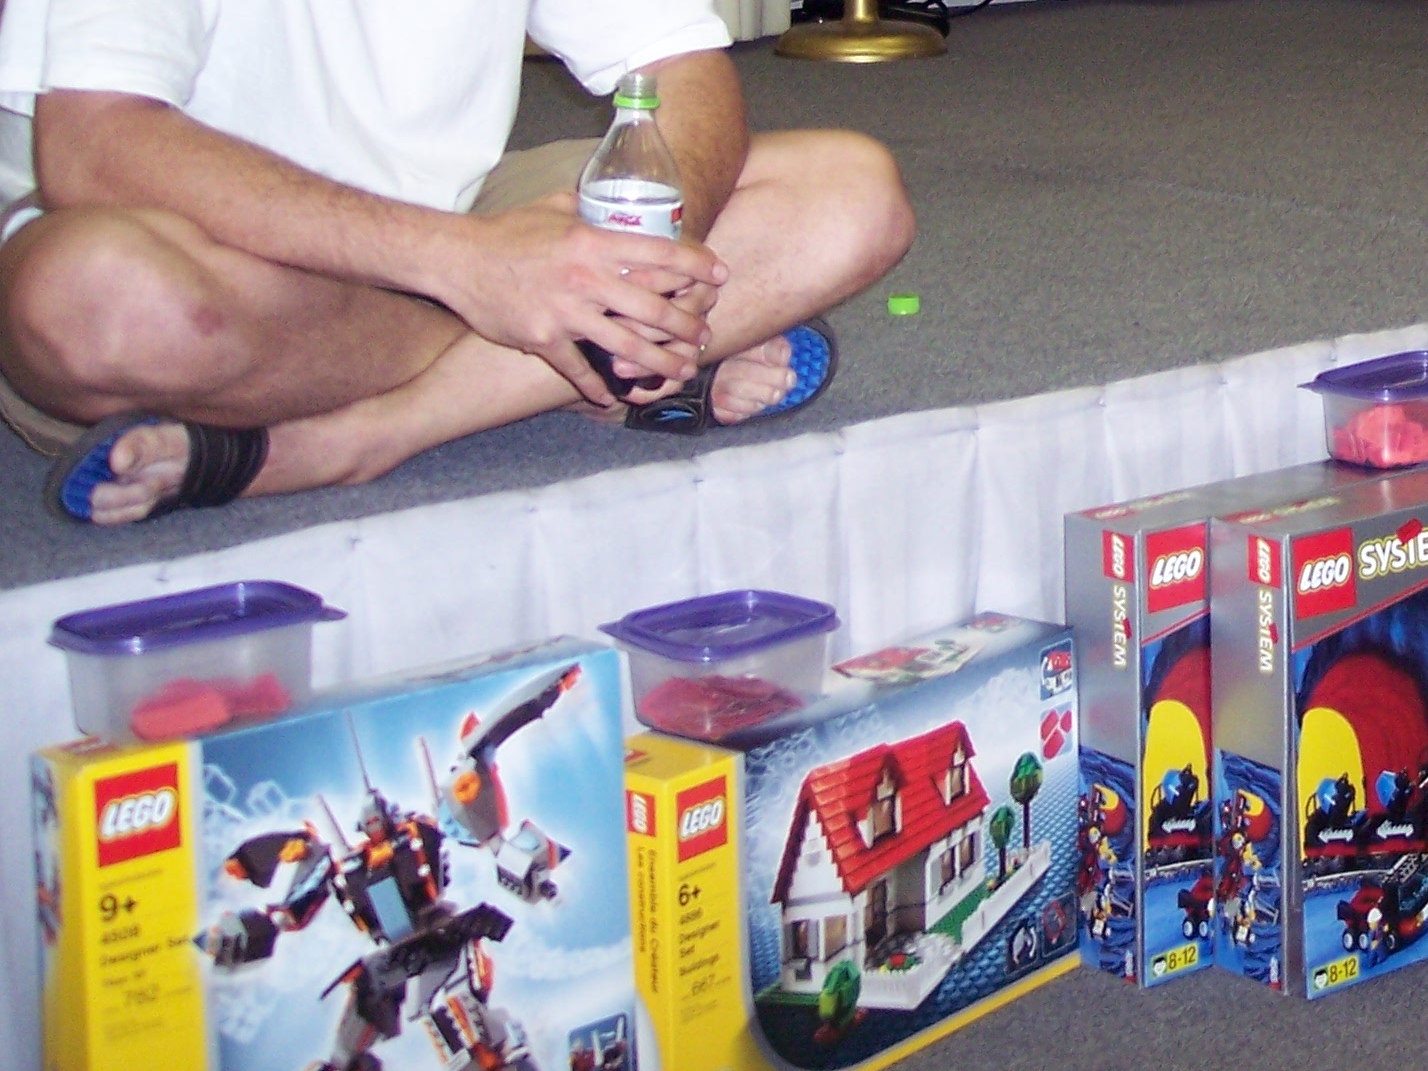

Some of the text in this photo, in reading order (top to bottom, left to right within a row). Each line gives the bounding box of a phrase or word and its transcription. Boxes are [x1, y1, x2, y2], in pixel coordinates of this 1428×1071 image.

[1151, 550, 1202, 586] LEGO
[1300, 556, 1349, 592] LEGO
[1111, 533, 1127, 666] LEGO SYSTEM
[1257, 538, 1273, 671] LEGO SYSTEM
[101, 790, 175, 837] LEGO
[681, 799, 724, 838] LEGO
[100, 893, 137, 922] 9+
[678, 883, 701, 907] 6+
[1168, 945, 1196, 970] 8-12
[1329, 958, 1357, 983] 8-12
